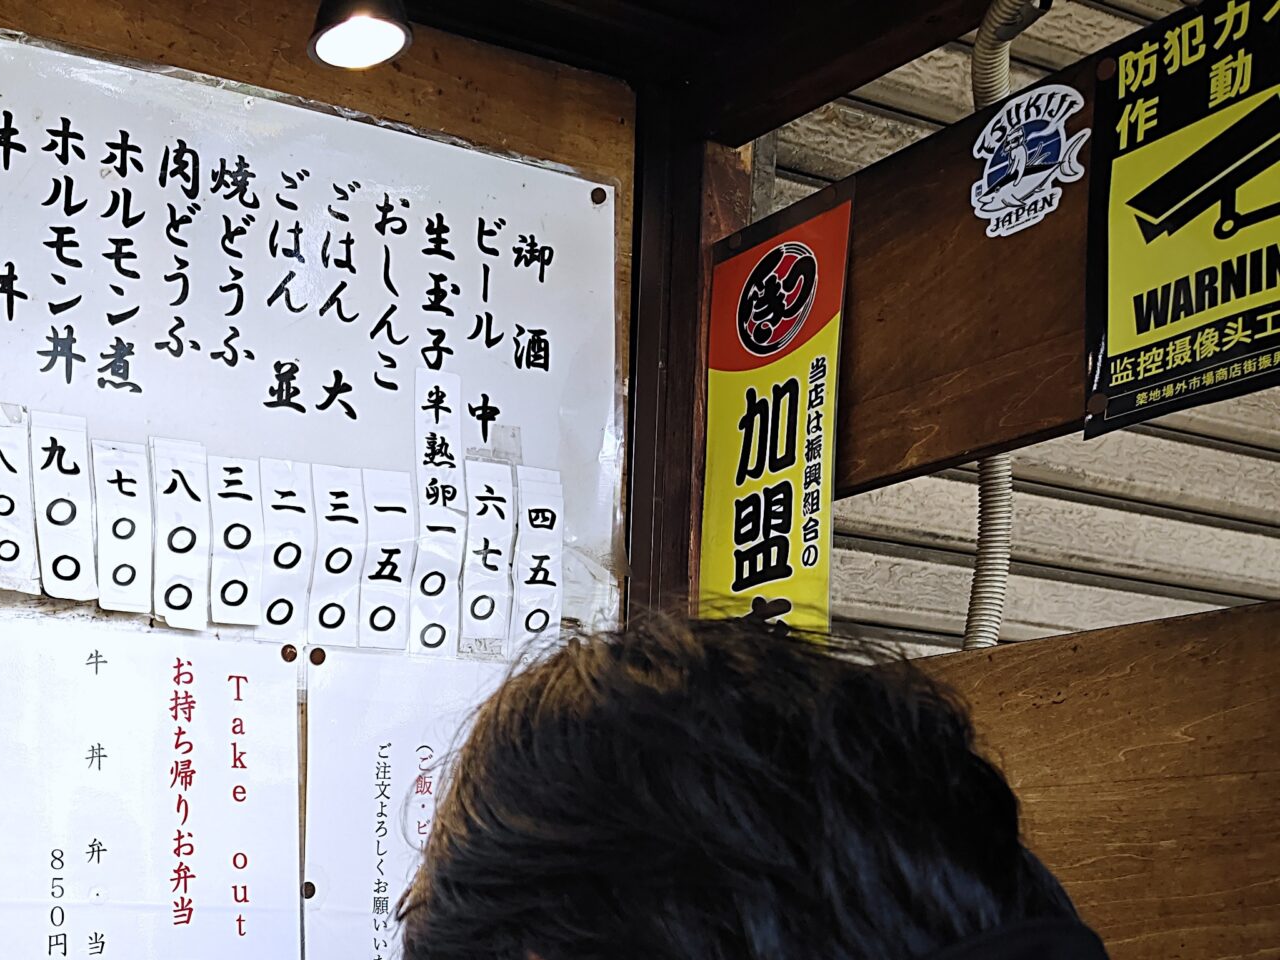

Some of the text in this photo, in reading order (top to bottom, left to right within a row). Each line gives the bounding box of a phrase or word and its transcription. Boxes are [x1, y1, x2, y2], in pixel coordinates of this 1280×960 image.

[36, 116, 88, 384] ホルモン丼
[97, 130, 146, 393] ホルモン煮
[154, 138, 201, 358] 肉どうふ
[210, 154, 260, 367] 焼どうふ
[369, 192, 410, 391] おしんこ
[990, 193, 1056, 233] JAPAN
[420, 385, 457, 506] 半熟卵
[731, 376, 801, 636] 加盟
[801, 356, 827, 568] 当店は振興組合の
[168, 657, 196, 927] お持ち帰りお弁当
[227, 674, 250, 937] Take out
[48, 848, 68, 957] 850円
